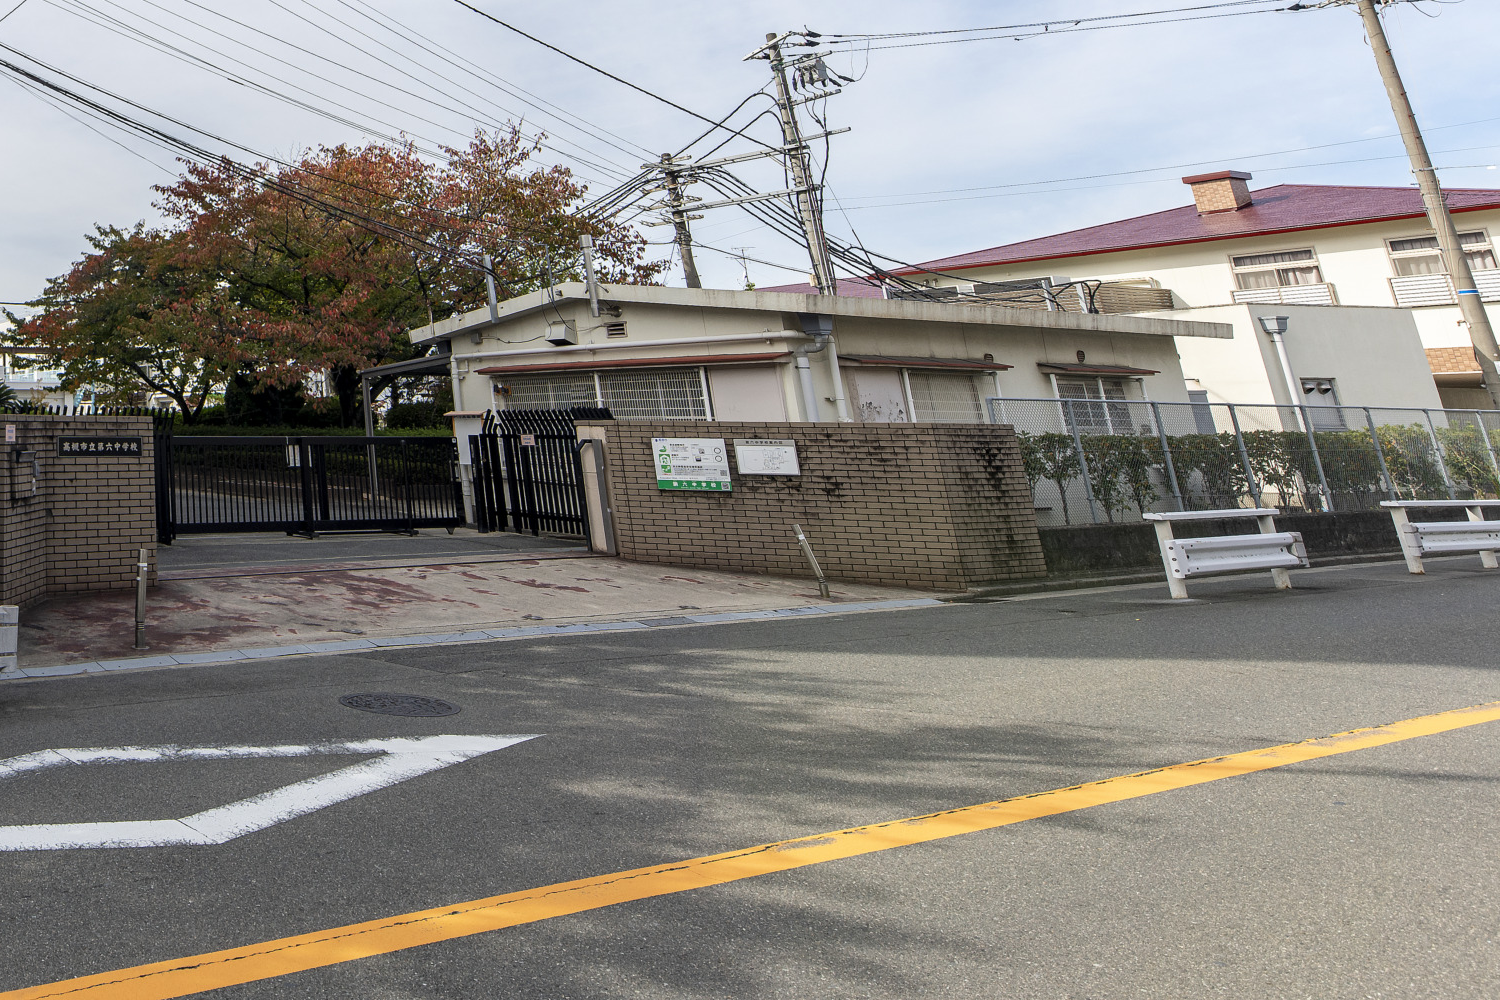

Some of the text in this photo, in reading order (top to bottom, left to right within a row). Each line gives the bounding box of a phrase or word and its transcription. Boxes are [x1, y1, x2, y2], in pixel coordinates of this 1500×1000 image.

[63, 442, 138, 452] 高槻市立第六中学校
